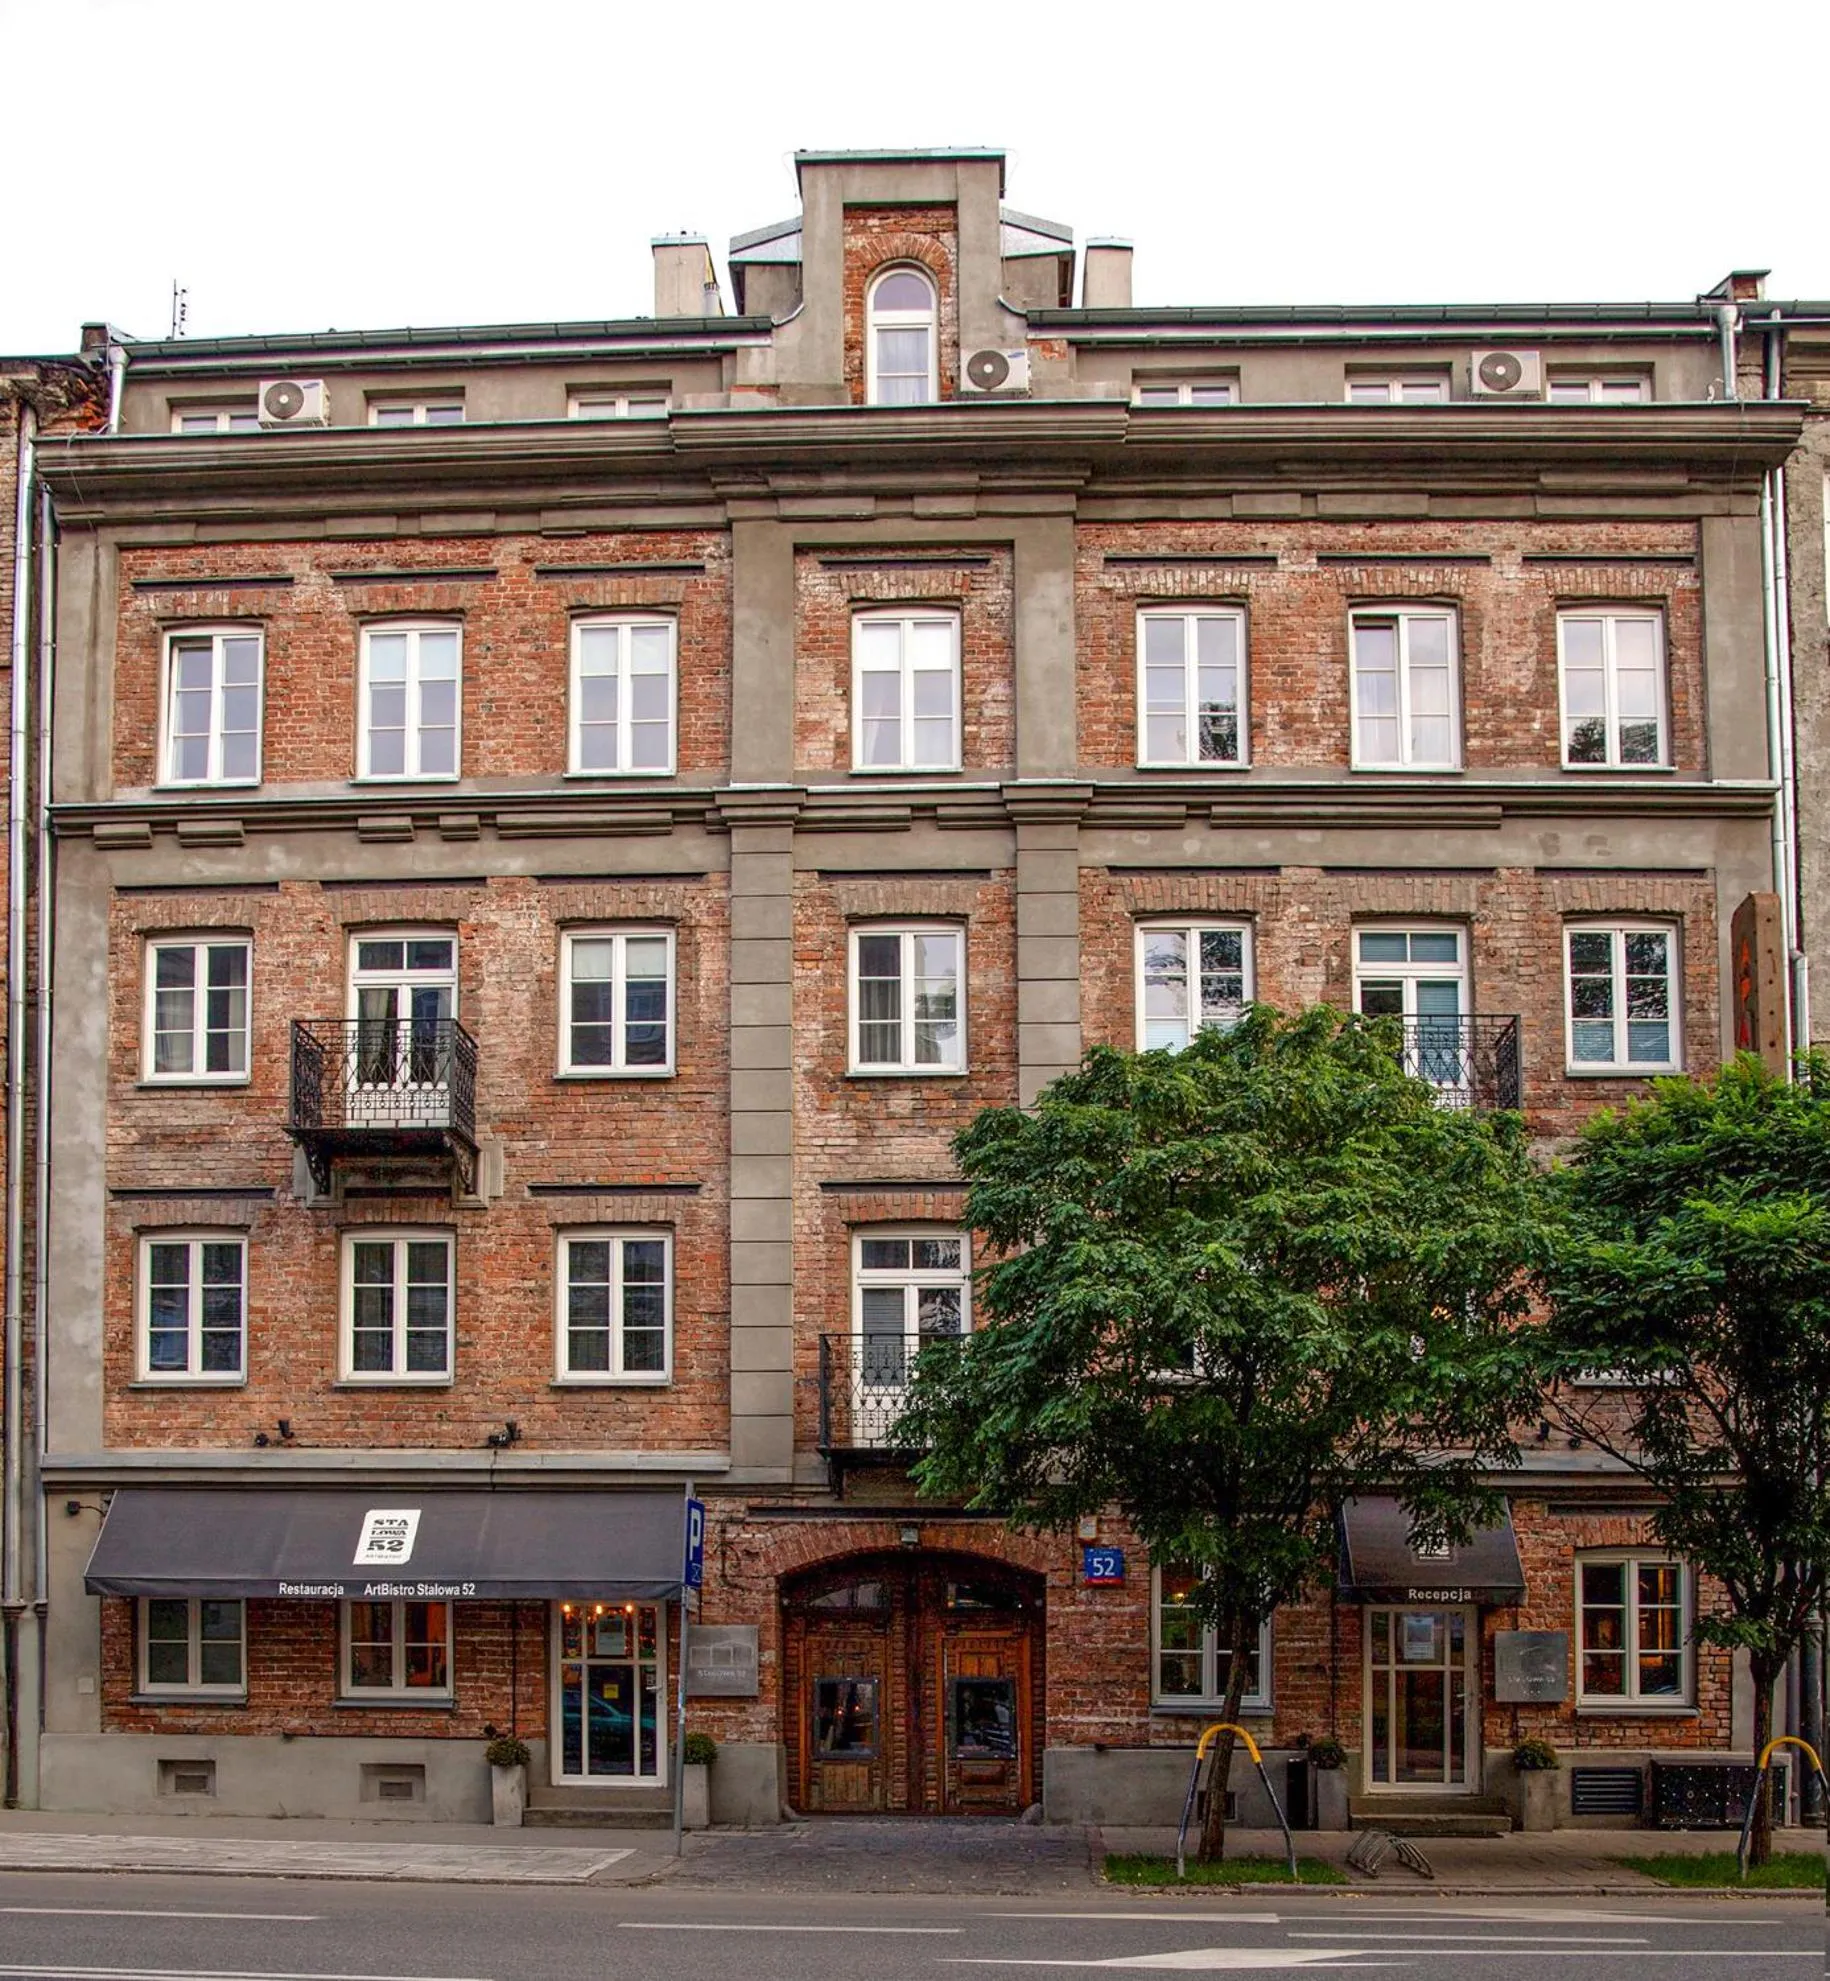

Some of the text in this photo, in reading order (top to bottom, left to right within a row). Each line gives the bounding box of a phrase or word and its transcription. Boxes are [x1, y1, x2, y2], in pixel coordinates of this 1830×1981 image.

[689, 1508, 700, 1561] P
[366, 1539, 405, 1552] 52
[1093, 1557, 1115, 1576] 52
[279, 1582, 476, 1597] Restauracja ArtBistro Stalowa 52
[1408, 1588, 1472, 1602] Recepcja
